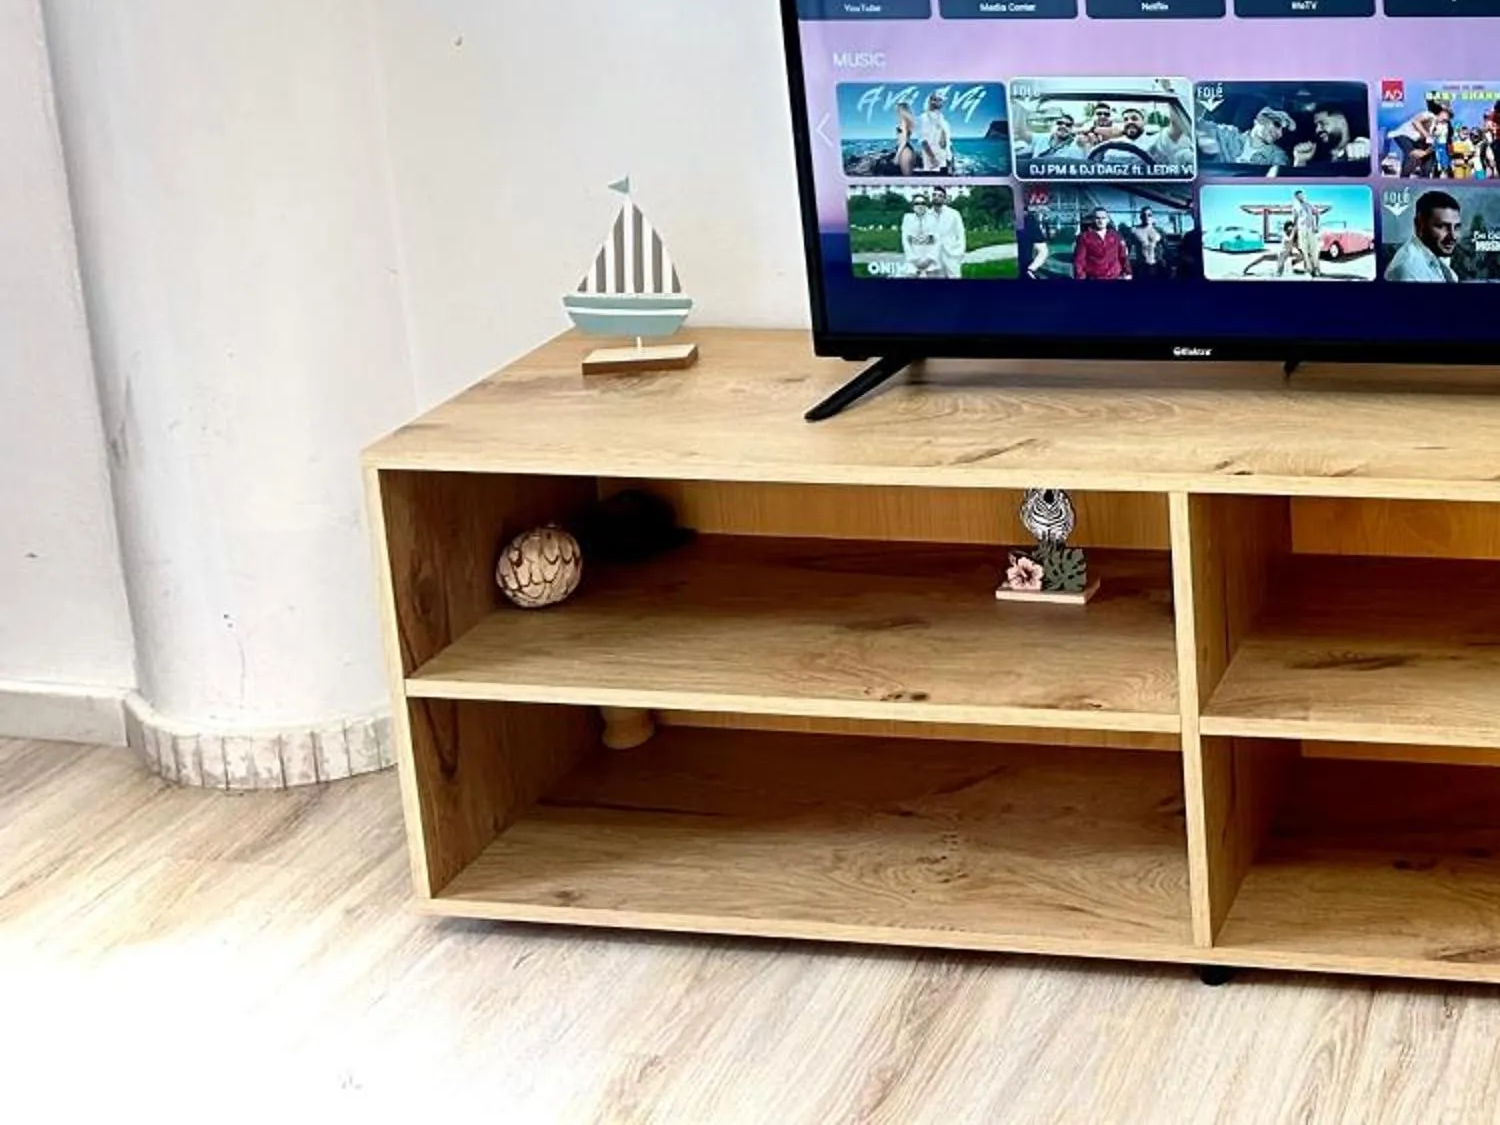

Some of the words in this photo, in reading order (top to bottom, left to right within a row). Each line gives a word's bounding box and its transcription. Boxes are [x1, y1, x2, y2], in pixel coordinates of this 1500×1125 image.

[979, 2, 1006, 12] Media
[1007, 2, 1036, 12] Center
[832, 52, 886, 68] MUSIC
[1029, 164, 1045, 175] DJ
[1079, 164, 1095, 175] DJ
